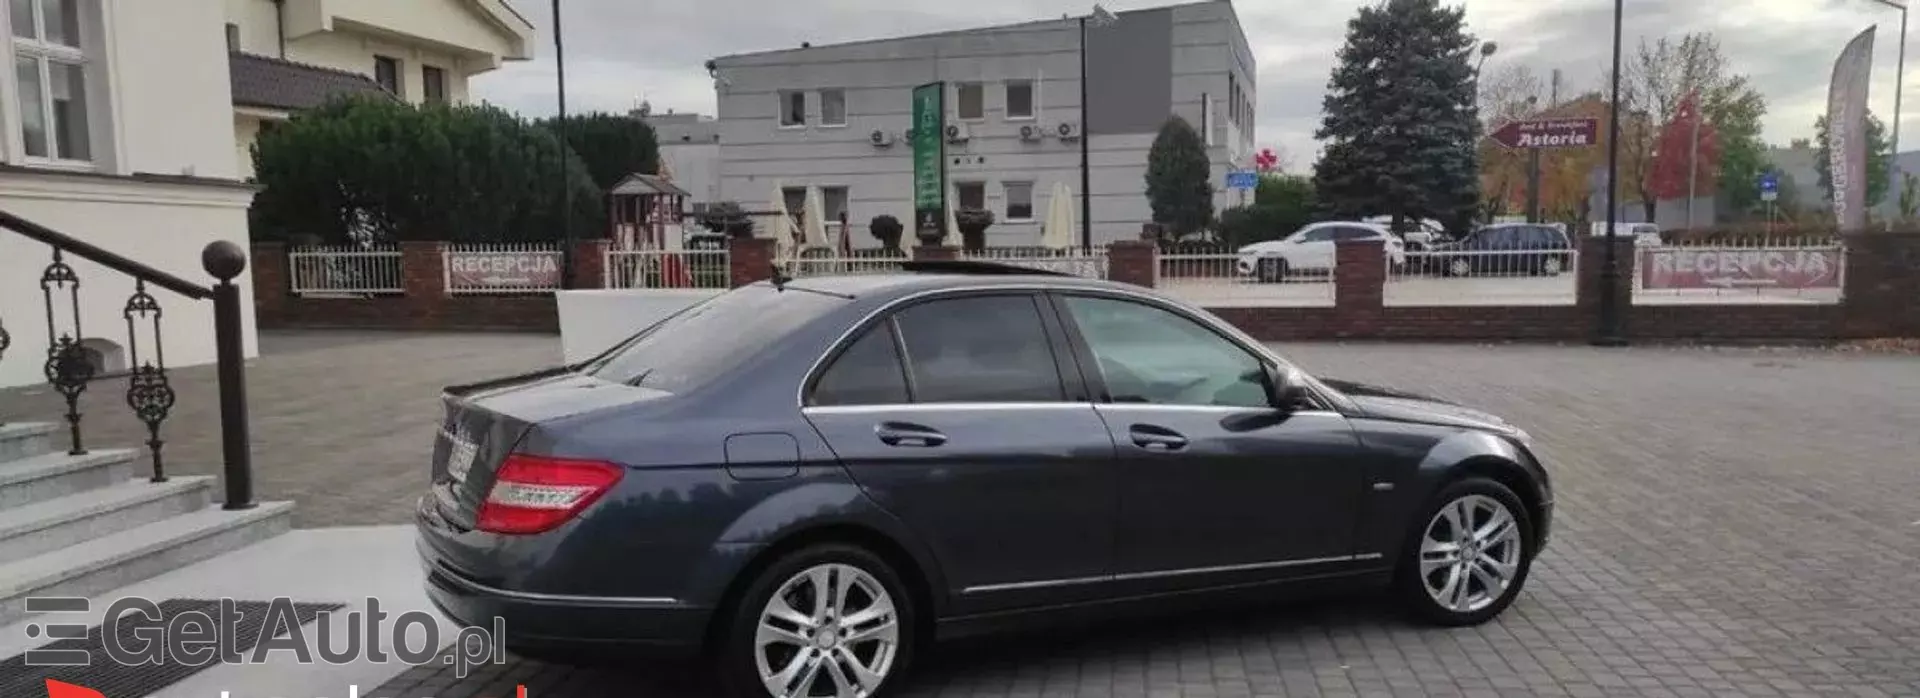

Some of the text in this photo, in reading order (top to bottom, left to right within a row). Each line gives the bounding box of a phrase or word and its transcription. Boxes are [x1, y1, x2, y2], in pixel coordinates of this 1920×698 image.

[1517, 131, 1587, 146] Astoria
[452, 256, 556, 273] RECEPCJA
[1652, 251, 1828, 274] RECEPCJA
